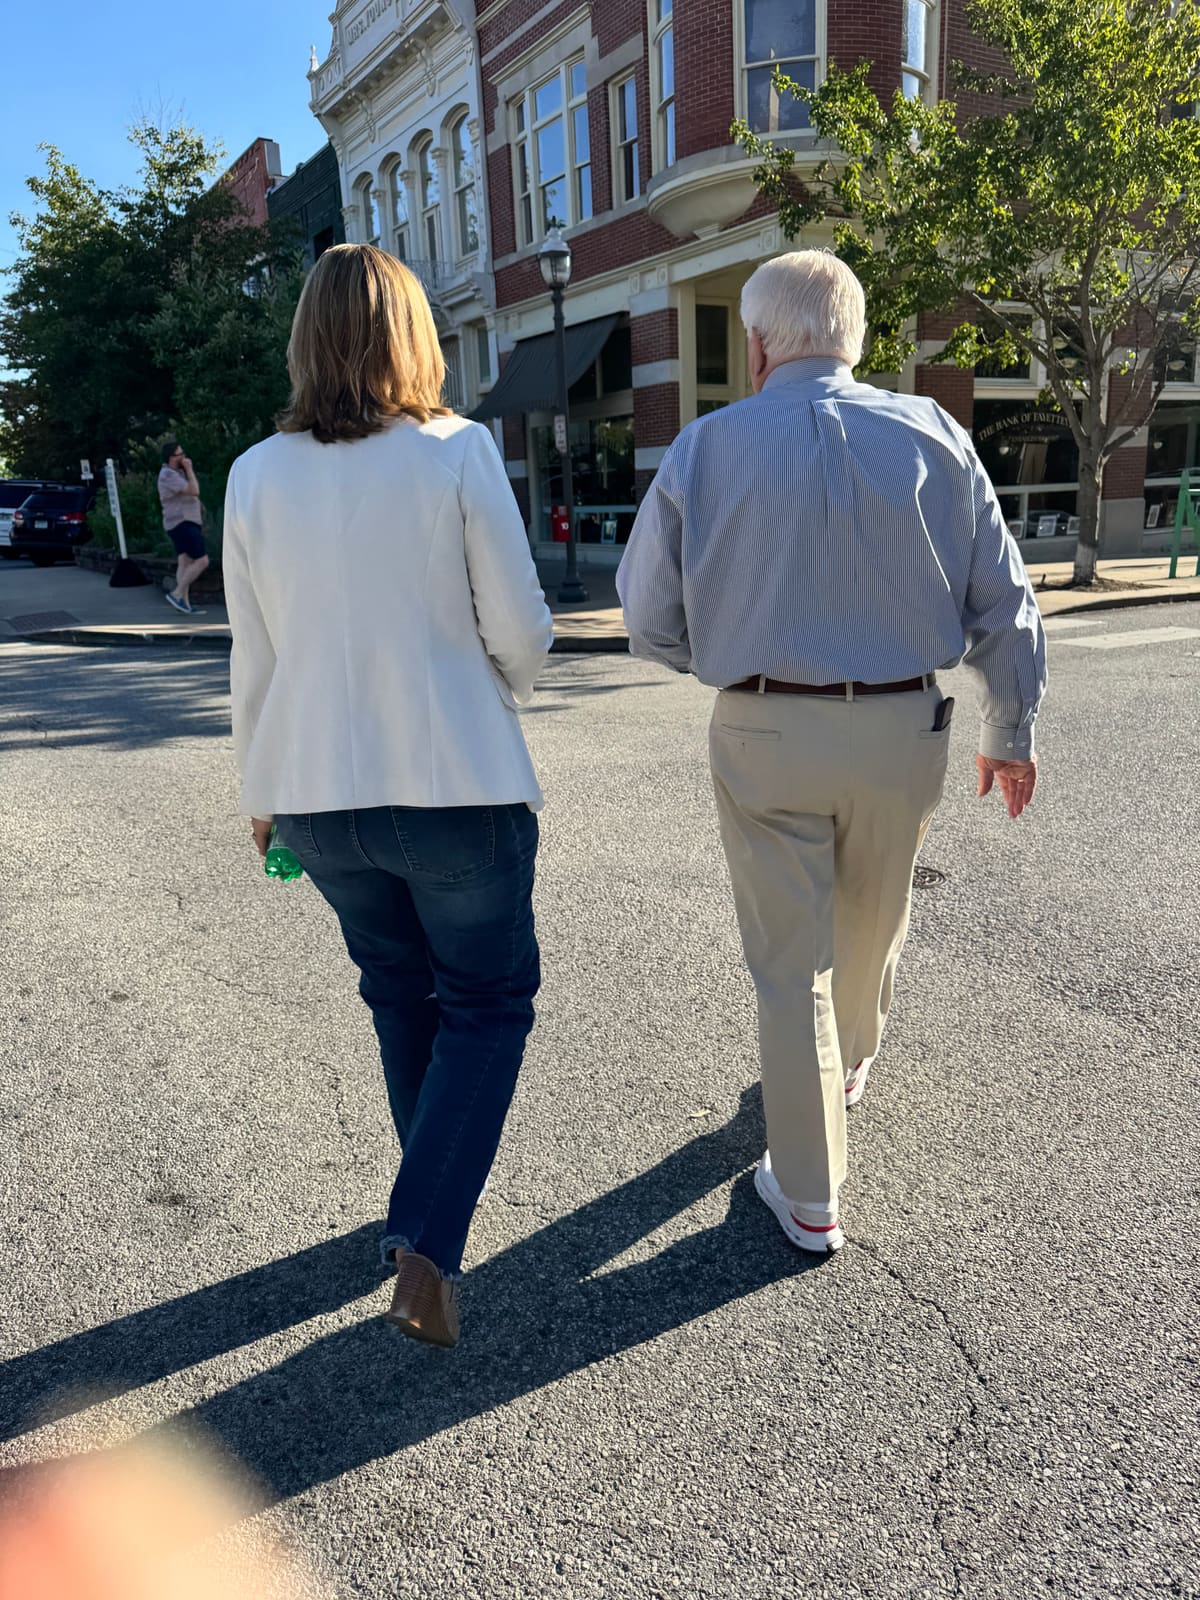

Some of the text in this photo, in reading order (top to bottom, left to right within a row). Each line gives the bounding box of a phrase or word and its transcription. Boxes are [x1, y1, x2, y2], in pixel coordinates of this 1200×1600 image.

[978, 425, 995, 441] THE
[996, 415, 1020, 431] BANK
[1020, 412, 1032, 424] OF
